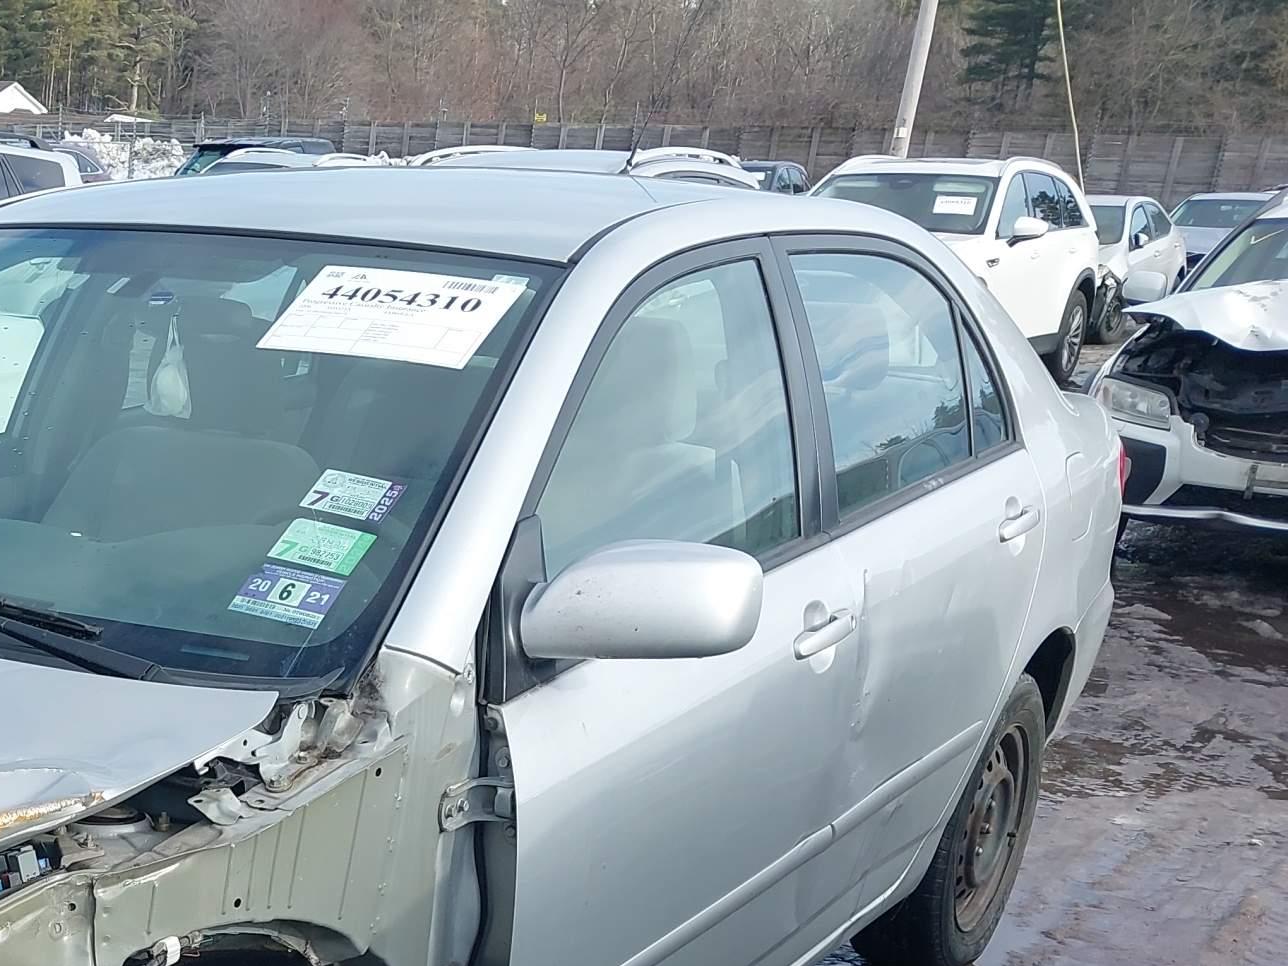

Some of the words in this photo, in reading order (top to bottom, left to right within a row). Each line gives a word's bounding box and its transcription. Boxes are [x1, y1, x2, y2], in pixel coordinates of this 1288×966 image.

[322, 285, 482, 313] 44054310
[306, 490, 330, 507] 7
[369, 489, 399, 521] 2025
[275, 540, 299, 557] 7
[247, 578, 272, 592] 20
[278, 582, 296, 601] 6
[305, 591, 330, 606] 21
